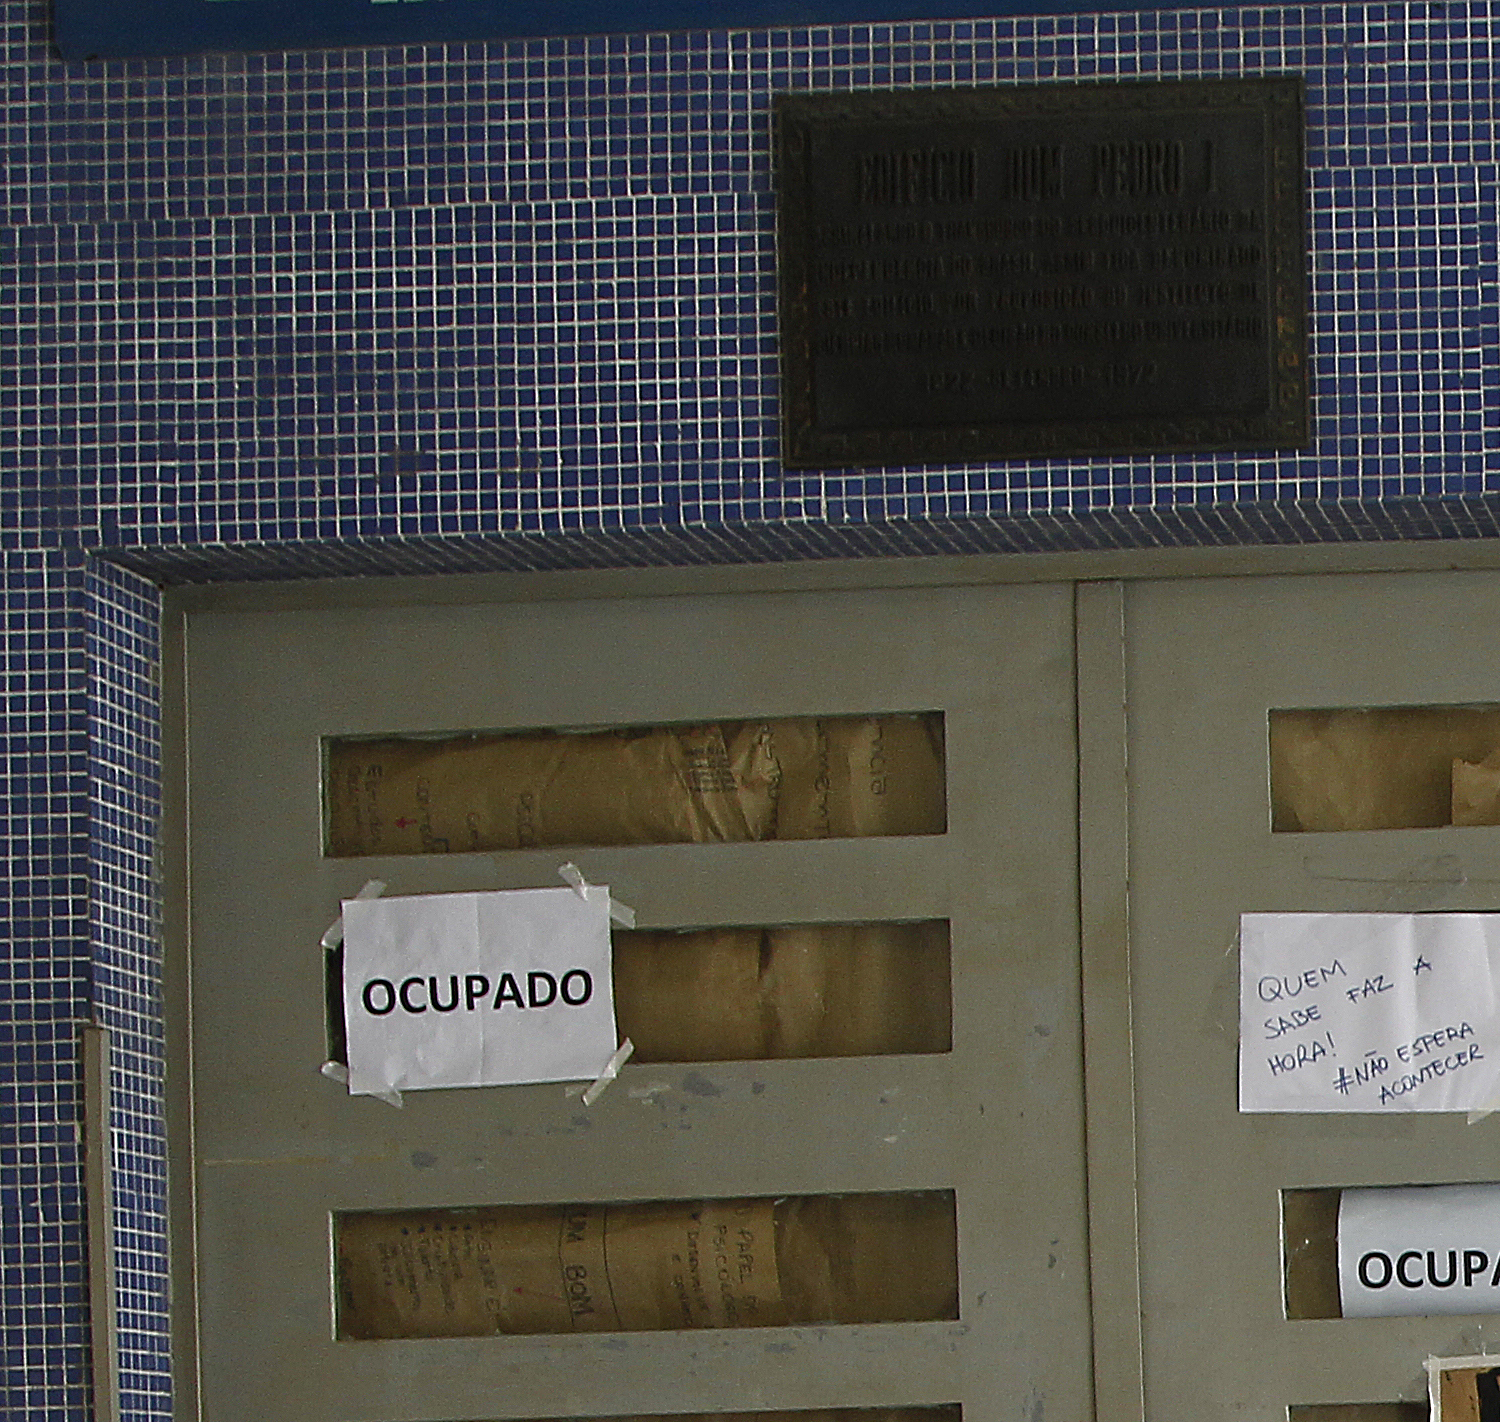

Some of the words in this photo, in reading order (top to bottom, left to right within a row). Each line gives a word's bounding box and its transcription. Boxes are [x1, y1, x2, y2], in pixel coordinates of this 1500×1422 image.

[361, 967, 593, 1018] OCUPADO
[1258, 959, 1348, 1003] QUEM
[1264, 1005, 1322, 1040] SABE
[1345, 974, 1395, 1005] FAZ
[1412, 953, 1432, 976] A
[1267, 1030, 1337, 1077] HORA!
[1395, 1022, 1475, 1064] ESPERA
[1378, 1042, 1485, 1106] ACONTECER
[564, 1264, 596, 1315] BOM
